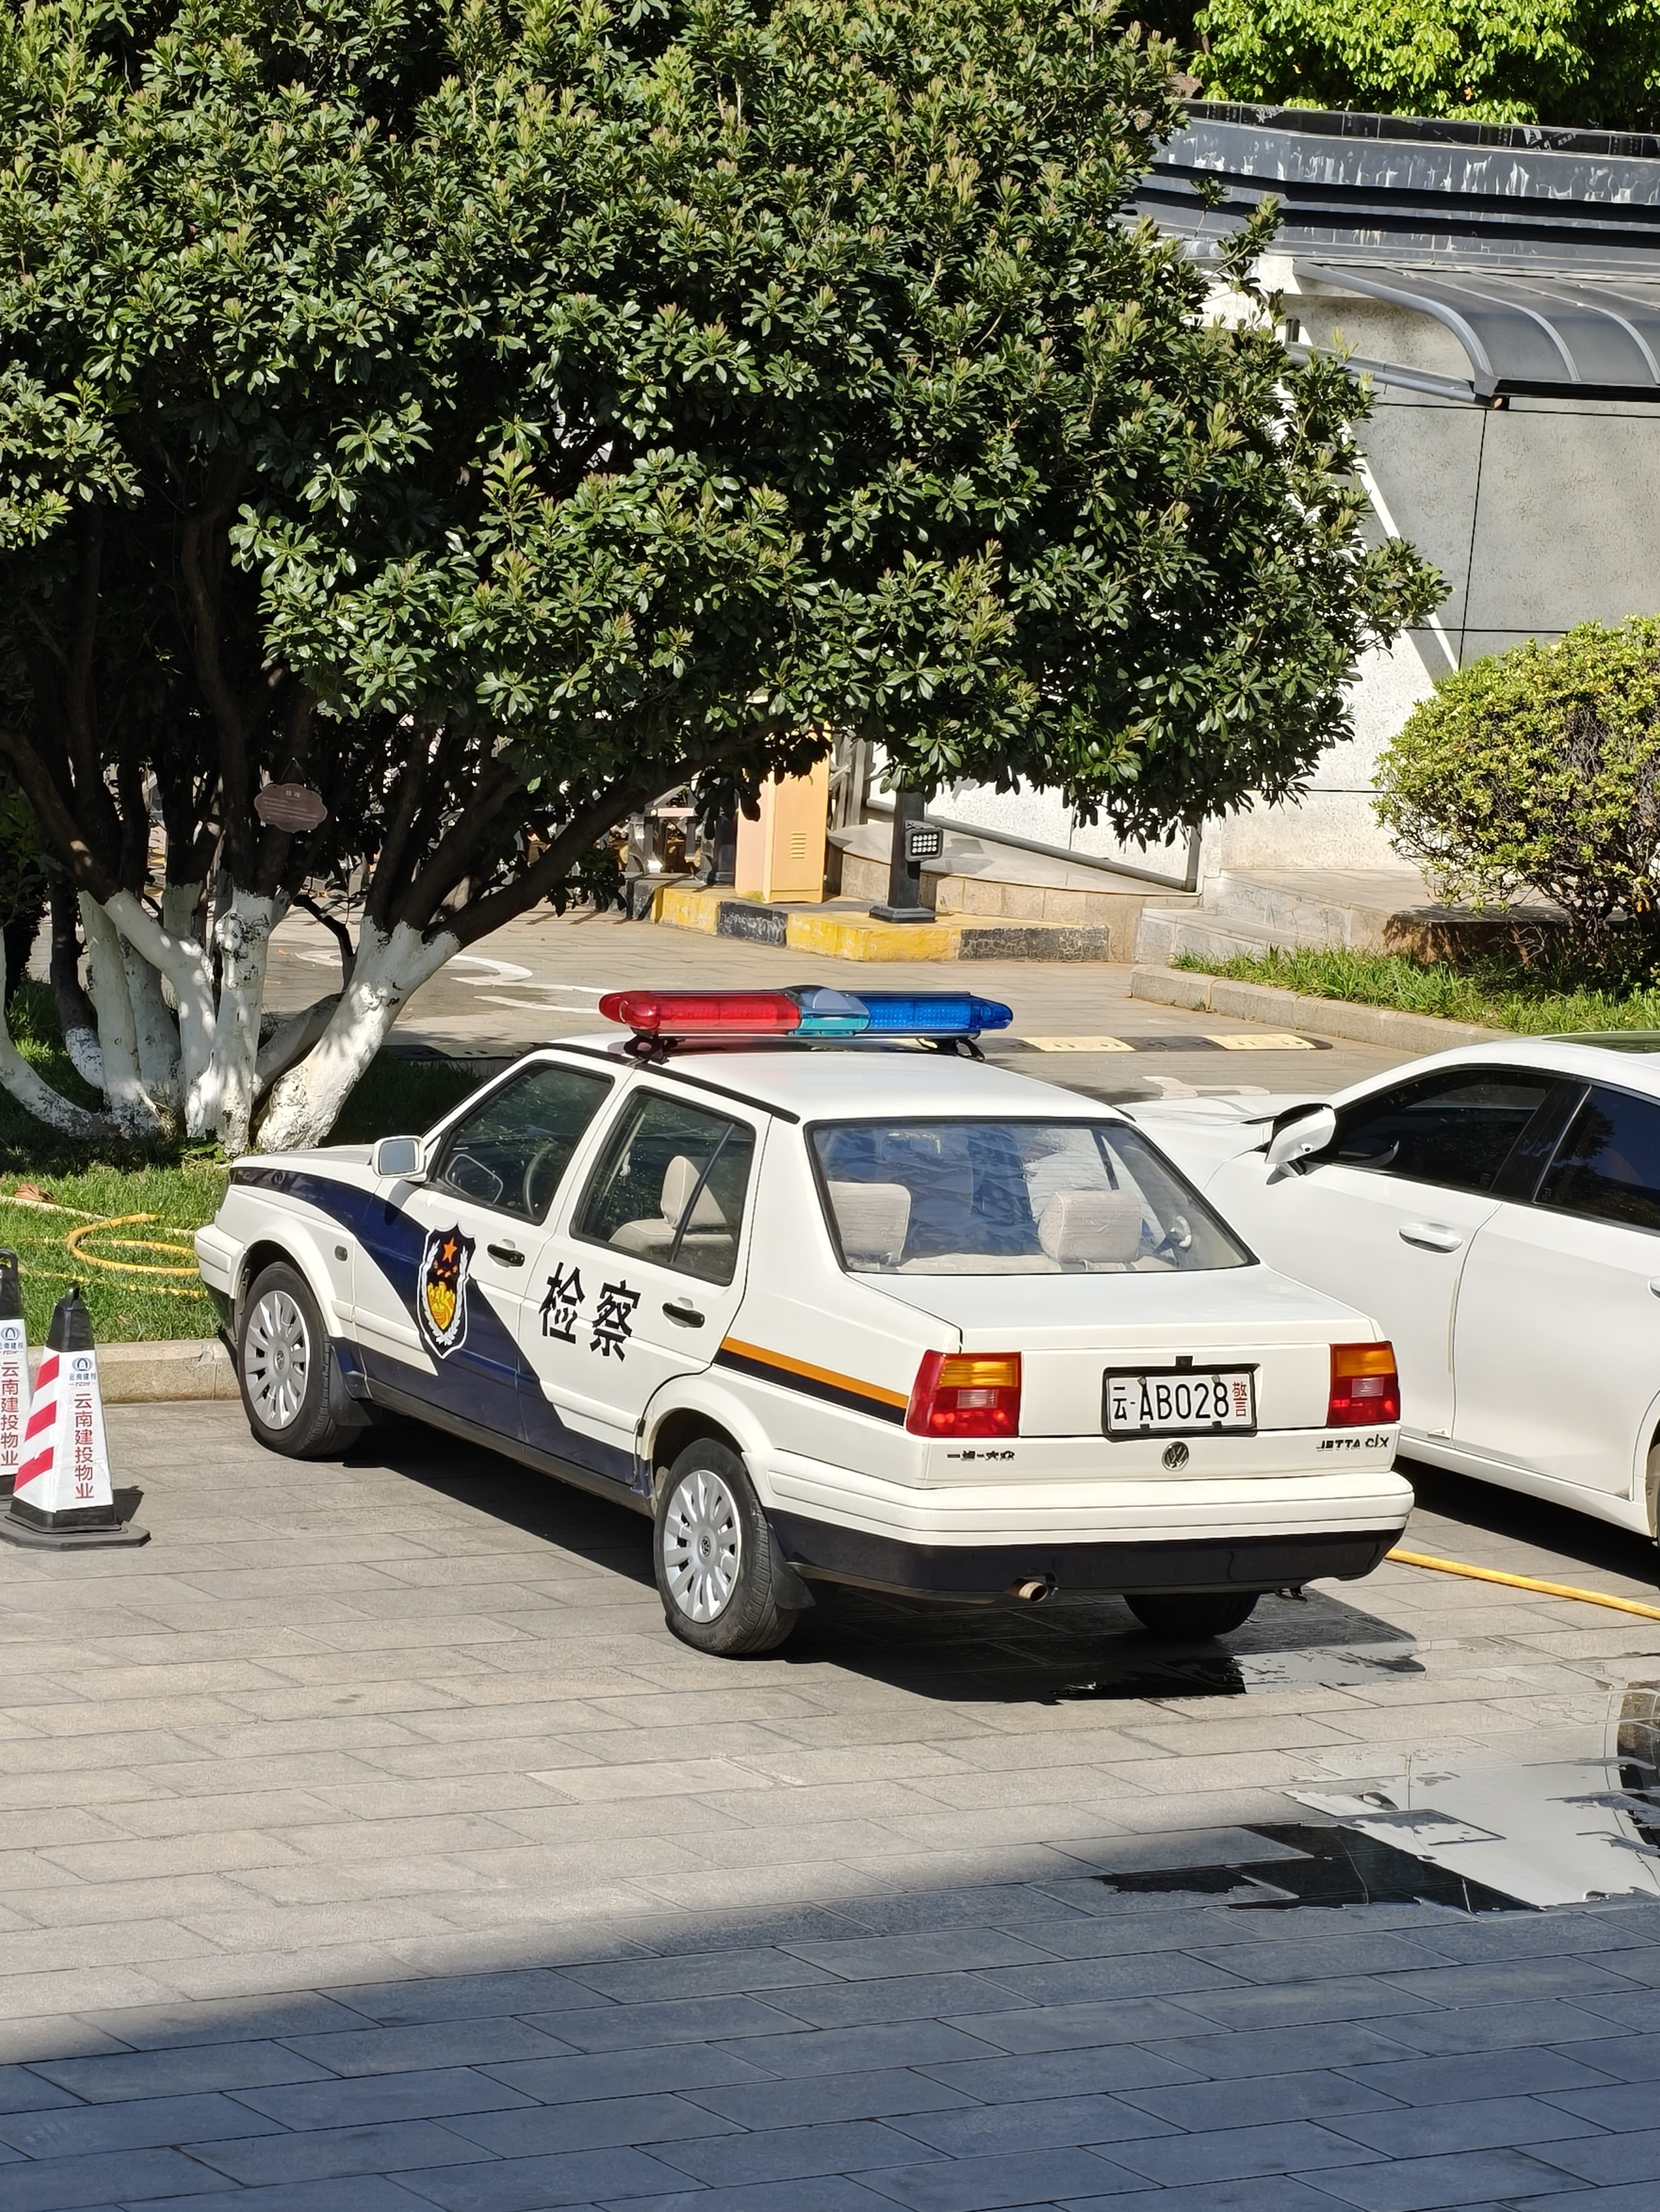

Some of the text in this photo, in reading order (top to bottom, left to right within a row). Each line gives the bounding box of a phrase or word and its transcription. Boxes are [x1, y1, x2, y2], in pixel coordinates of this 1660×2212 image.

[539, 1262, 641, 1361] 检察
[1, 1362, 20, 1466] 云南建投物业
[74, 1393, 94, 1499] 云南建投物业
[1316, 1439, 1360, 1450] JETTA
